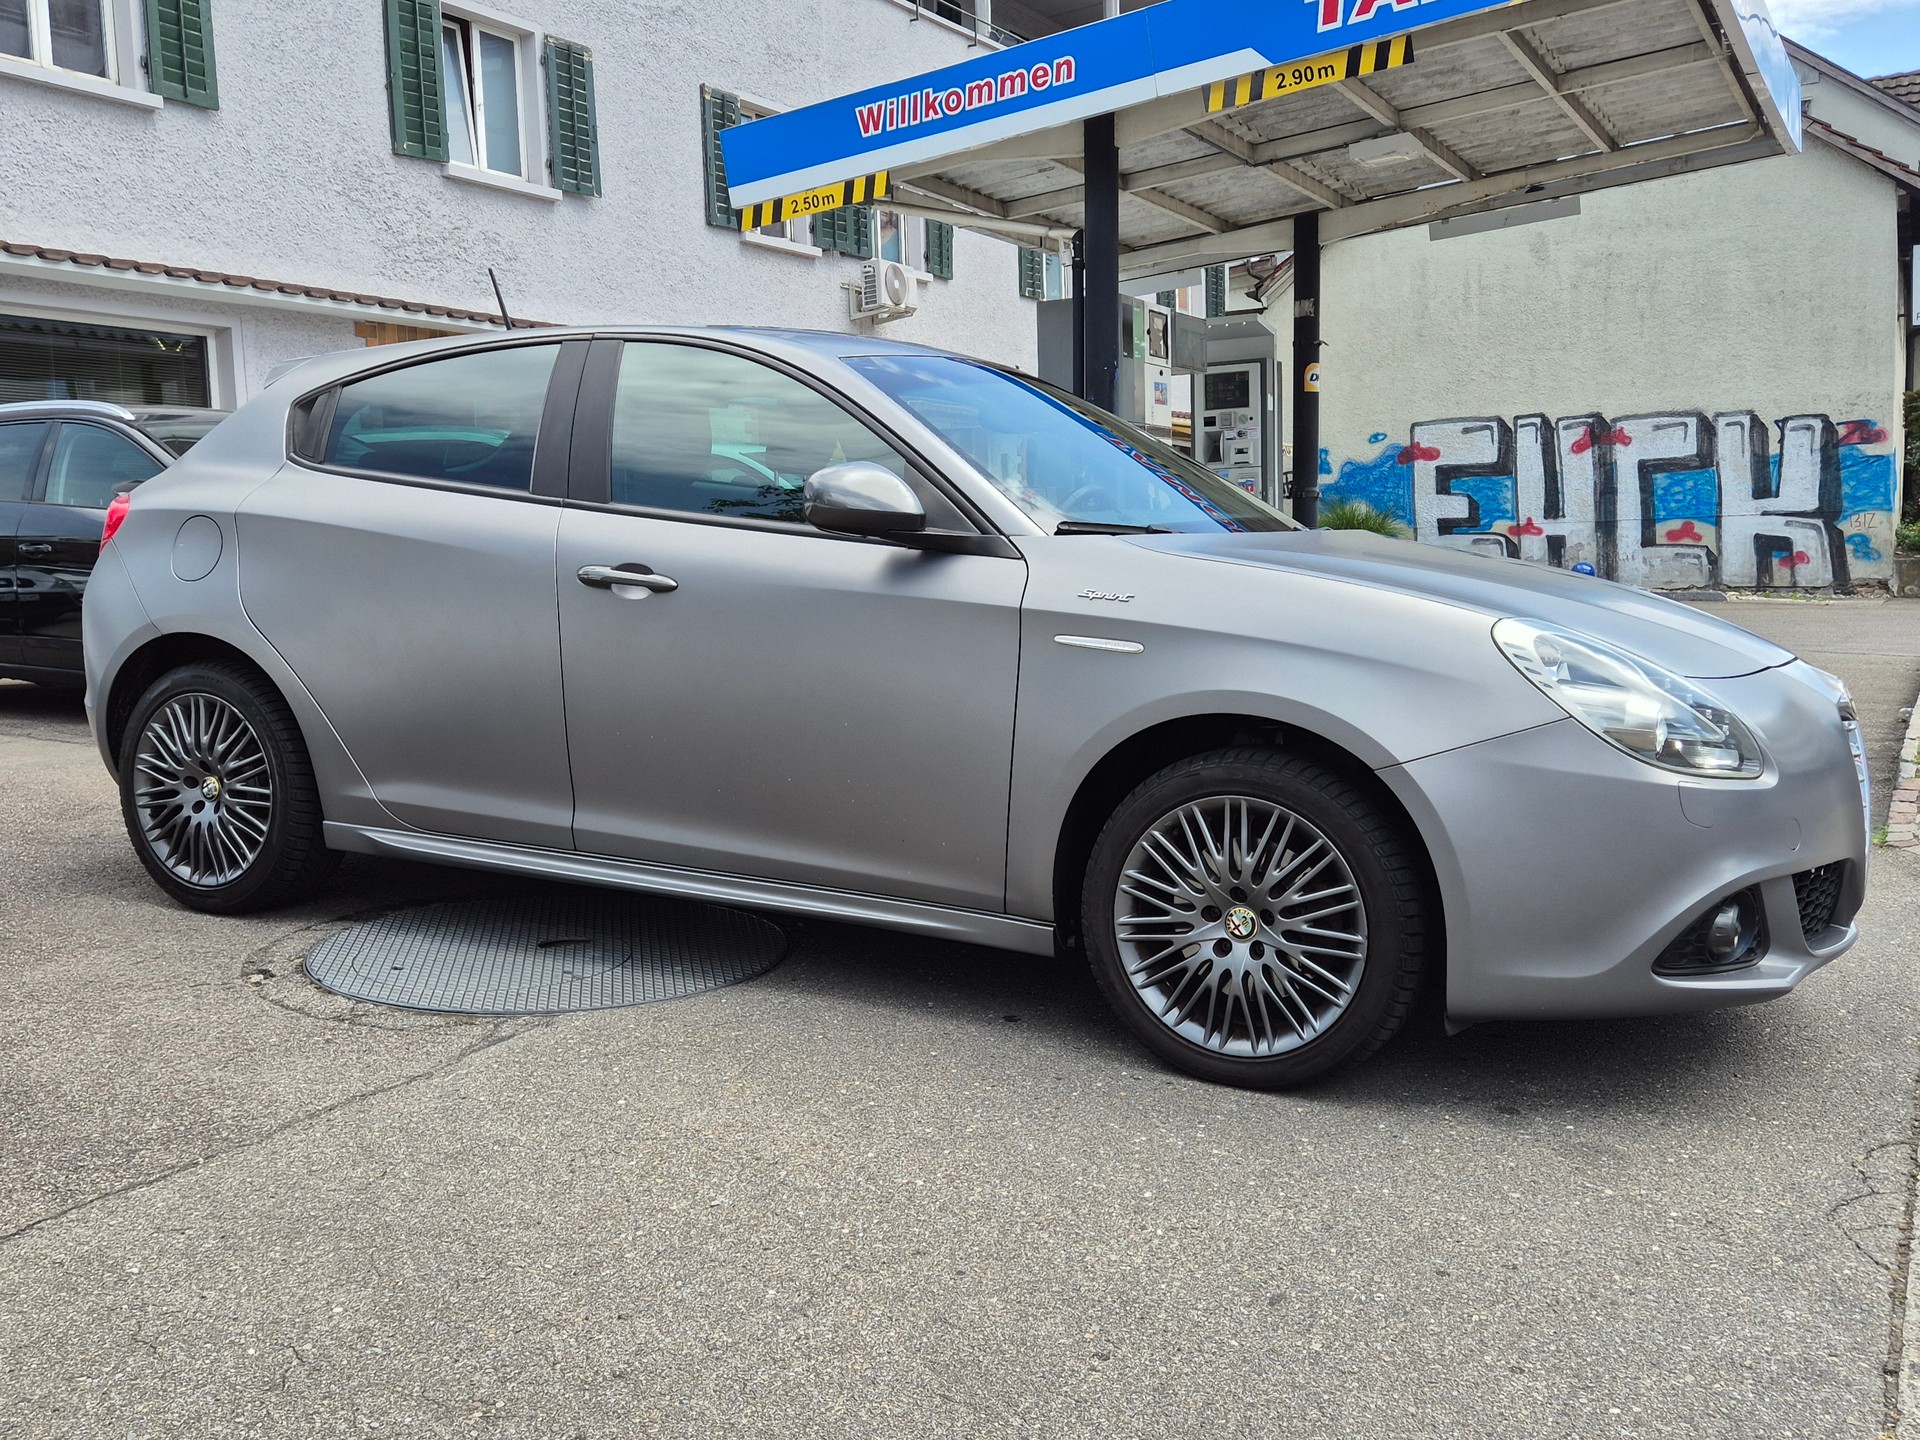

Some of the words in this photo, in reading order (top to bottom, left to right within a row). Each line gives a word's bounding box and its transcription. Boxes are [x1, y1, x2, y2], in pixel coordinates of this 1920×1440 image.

[1275, 69, 1315, 90] 2.90
[1317, 64, 1336, 79] m
[856, 55, 1076, 137] Willkommen
[790, 194, 820, 214] 2.50
[822, 192, 835, 206] m
[1077, 588, 1136, 602] Sprint
